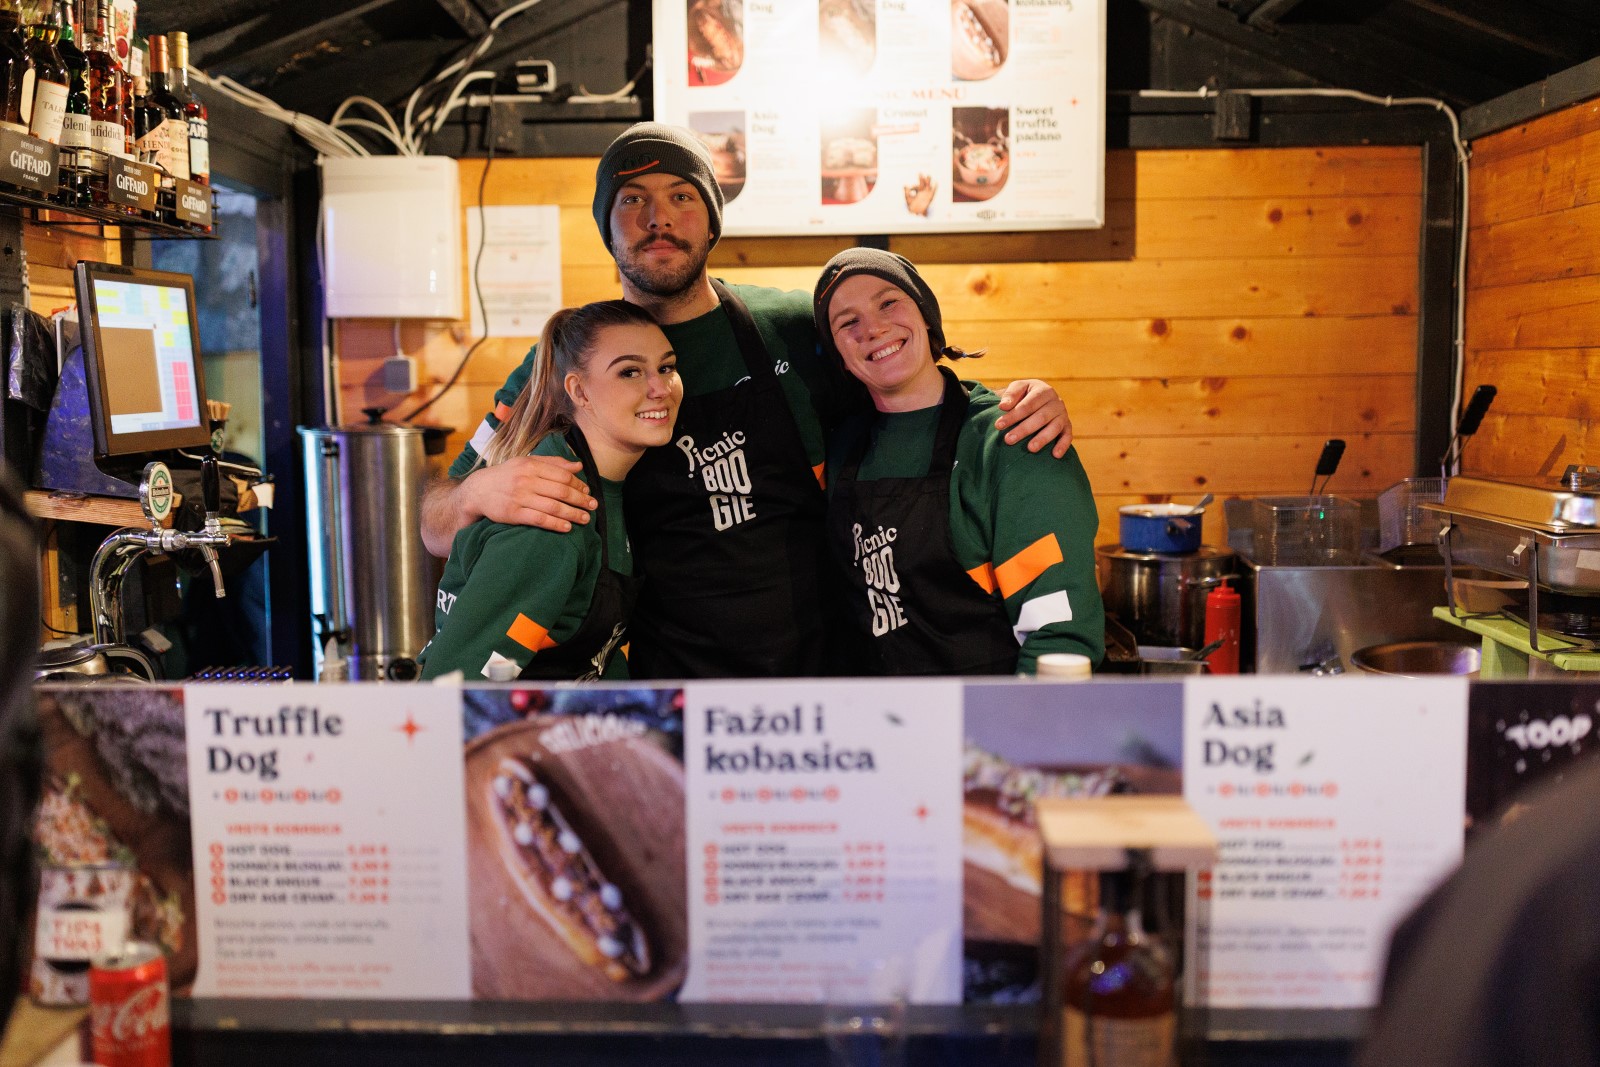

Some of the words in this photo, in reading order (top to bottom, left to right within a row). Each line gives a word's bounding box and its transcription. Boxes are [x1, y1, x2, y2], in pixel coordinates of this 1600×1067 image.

[1015, 105, 1053, 116] Sweet
[1015, 118, 1059, 129] truffle
[1015, 130, 1062, 144] padano
[676, 430, 746, 479] Picnic
[701, 448, 752, 494] BOO
[709, 494, 757, 532] GIE
[851, 522, 898, 567] Picnic
[862, 545, 900, 594] BOO
[867, 587, 909, 638] GIE
[205, 706, 344, 737] Truffle
[815, 704, 824, 735] i
[1202, 698, 1286, 729] Asia
[207, 747, 280, 781] Dog
[705, 743, 878, 773] kobasica
[1203, 740, 1275, 773] Dog
